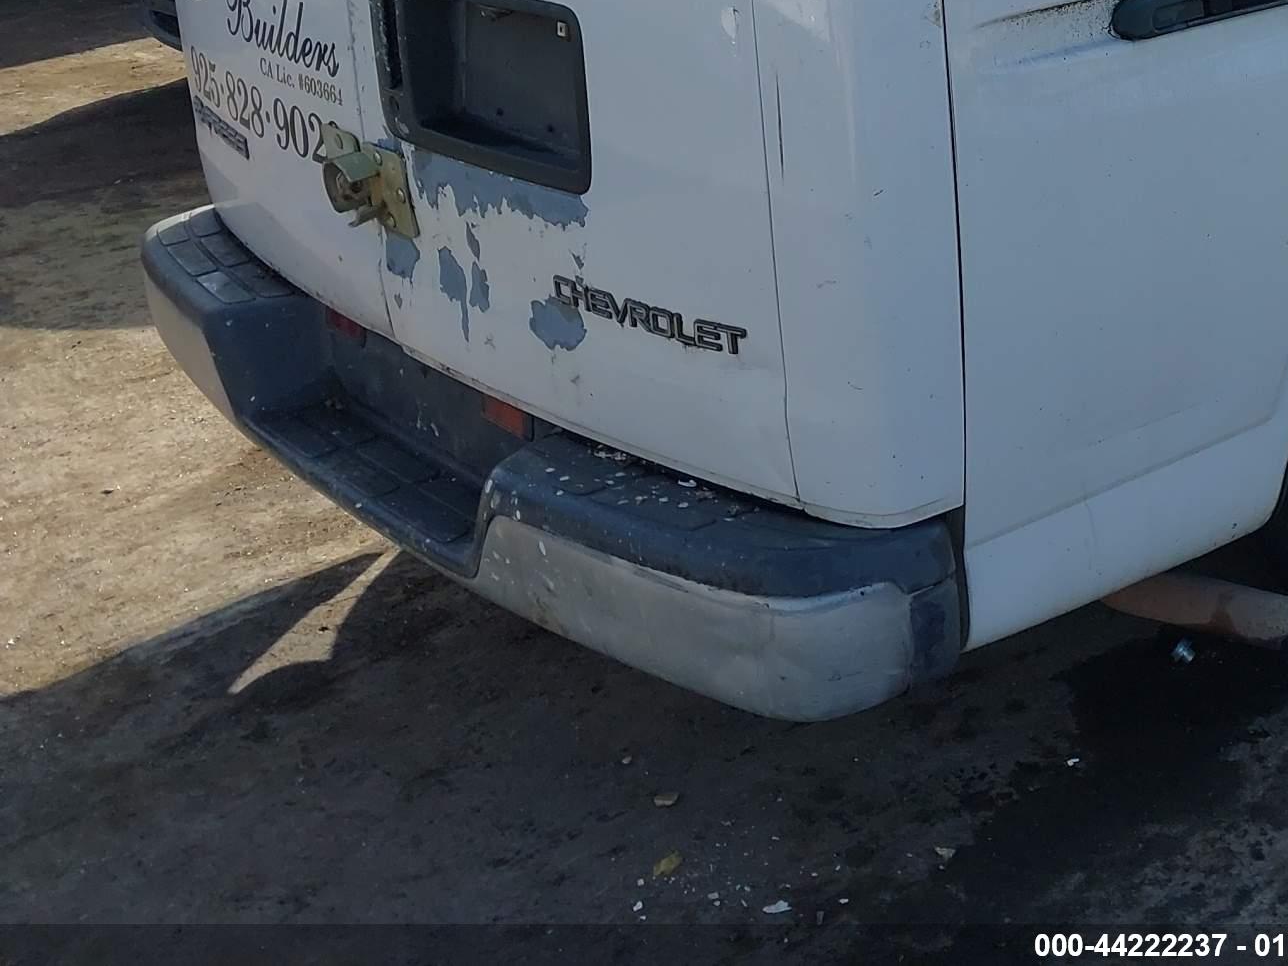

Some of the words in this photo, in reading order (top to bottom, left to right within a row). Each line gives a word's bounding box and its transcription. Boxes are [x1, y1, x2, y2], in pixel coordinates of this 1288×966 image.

[190, 45, 339, 164] 925·828·902
[260, 57, 274, 79] CA
[276, 64, 296, 89] Lic.
[297, 73, 344, 106] #603664
[553, 274, 747, 355] CHEVROLET
